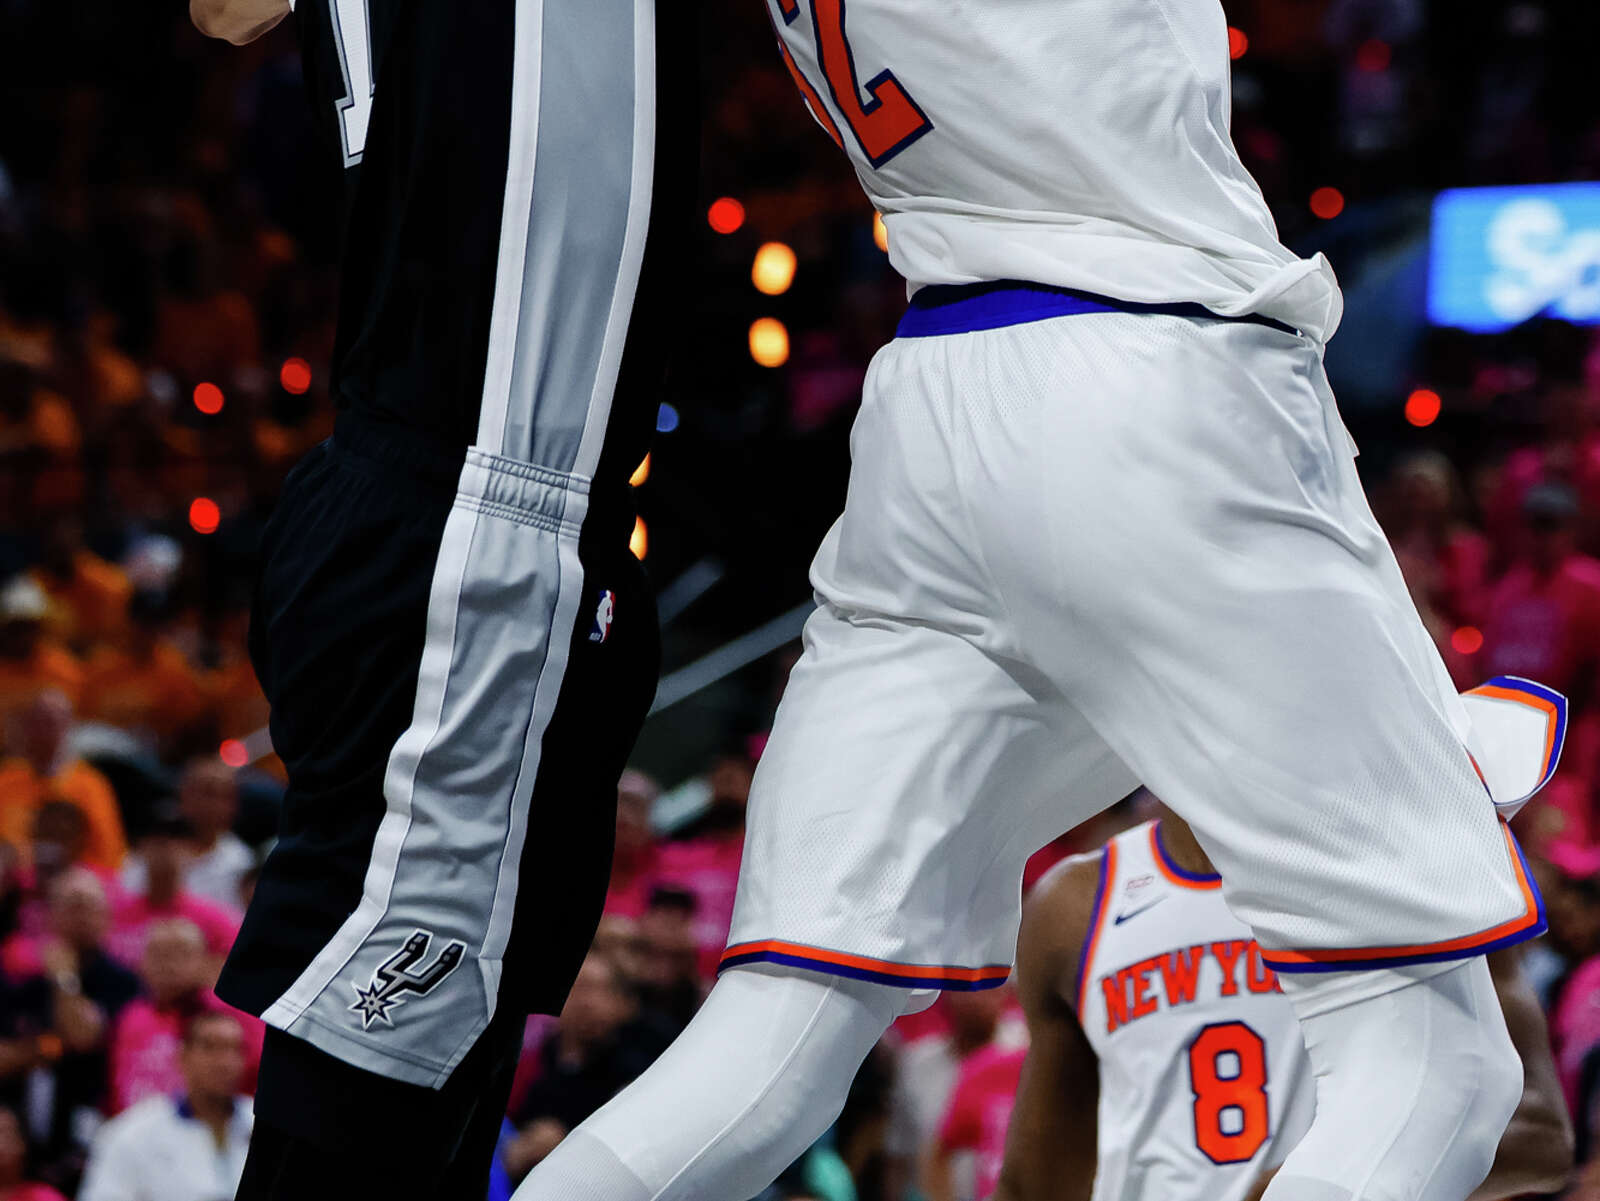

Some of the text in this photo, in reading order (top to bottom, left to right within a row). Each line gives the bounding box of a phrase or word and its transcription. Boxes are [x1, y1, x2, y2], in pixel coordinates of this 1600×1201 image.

[1100, 938, 1286, 1036] NEW YO
[1189, 1020, 1271, 1165] 8
